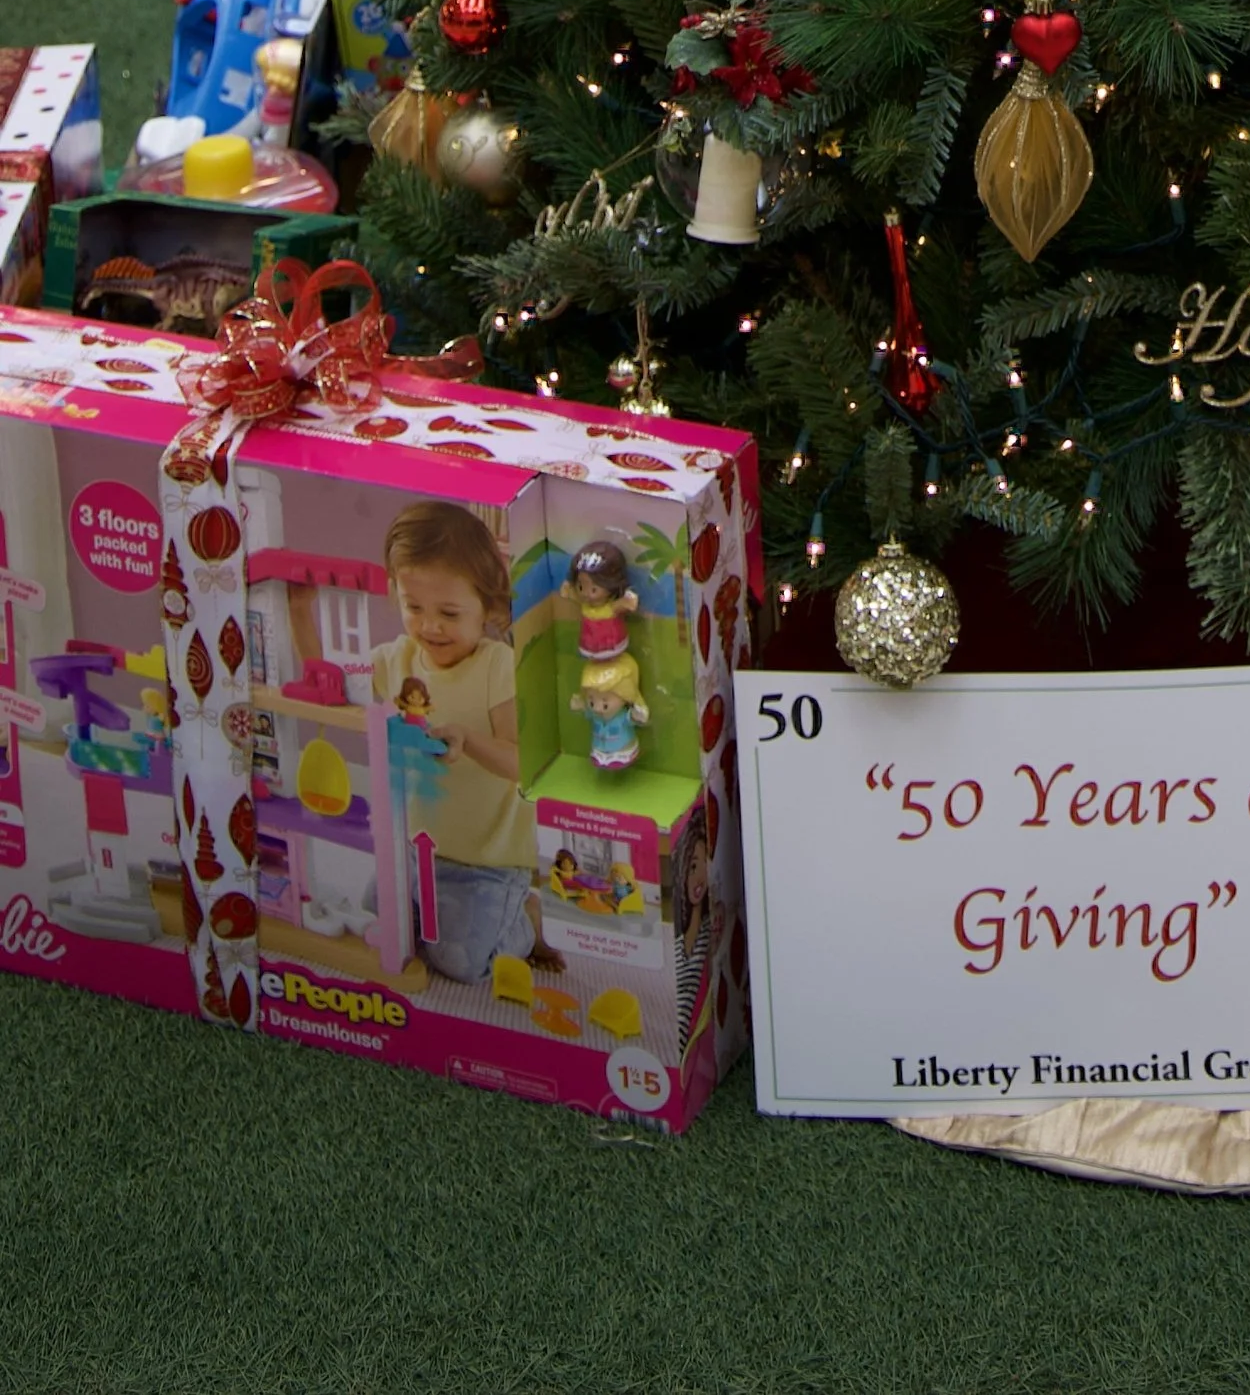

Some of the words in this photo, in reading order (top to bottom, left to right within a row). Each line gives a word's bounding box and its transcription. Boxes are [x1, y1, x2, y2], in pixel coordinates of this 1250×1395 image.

[79, 504, 94, 526] 3
[97, 508, 160, 540] floors
[90, 551, 122, 570] with
[125, 556, 154, 576] fun!
[93, 534, 148, 557] packed
[757, 693, 823, 742] 50
[1015, 763, 1218, 828] Years
[0, 897, 67, 961] bie
[953, 881, 1237, 982] Giving”
[892, 1057, 1021, 1093] Liberty
[1031, 1051, 1192, 1086] Financial
